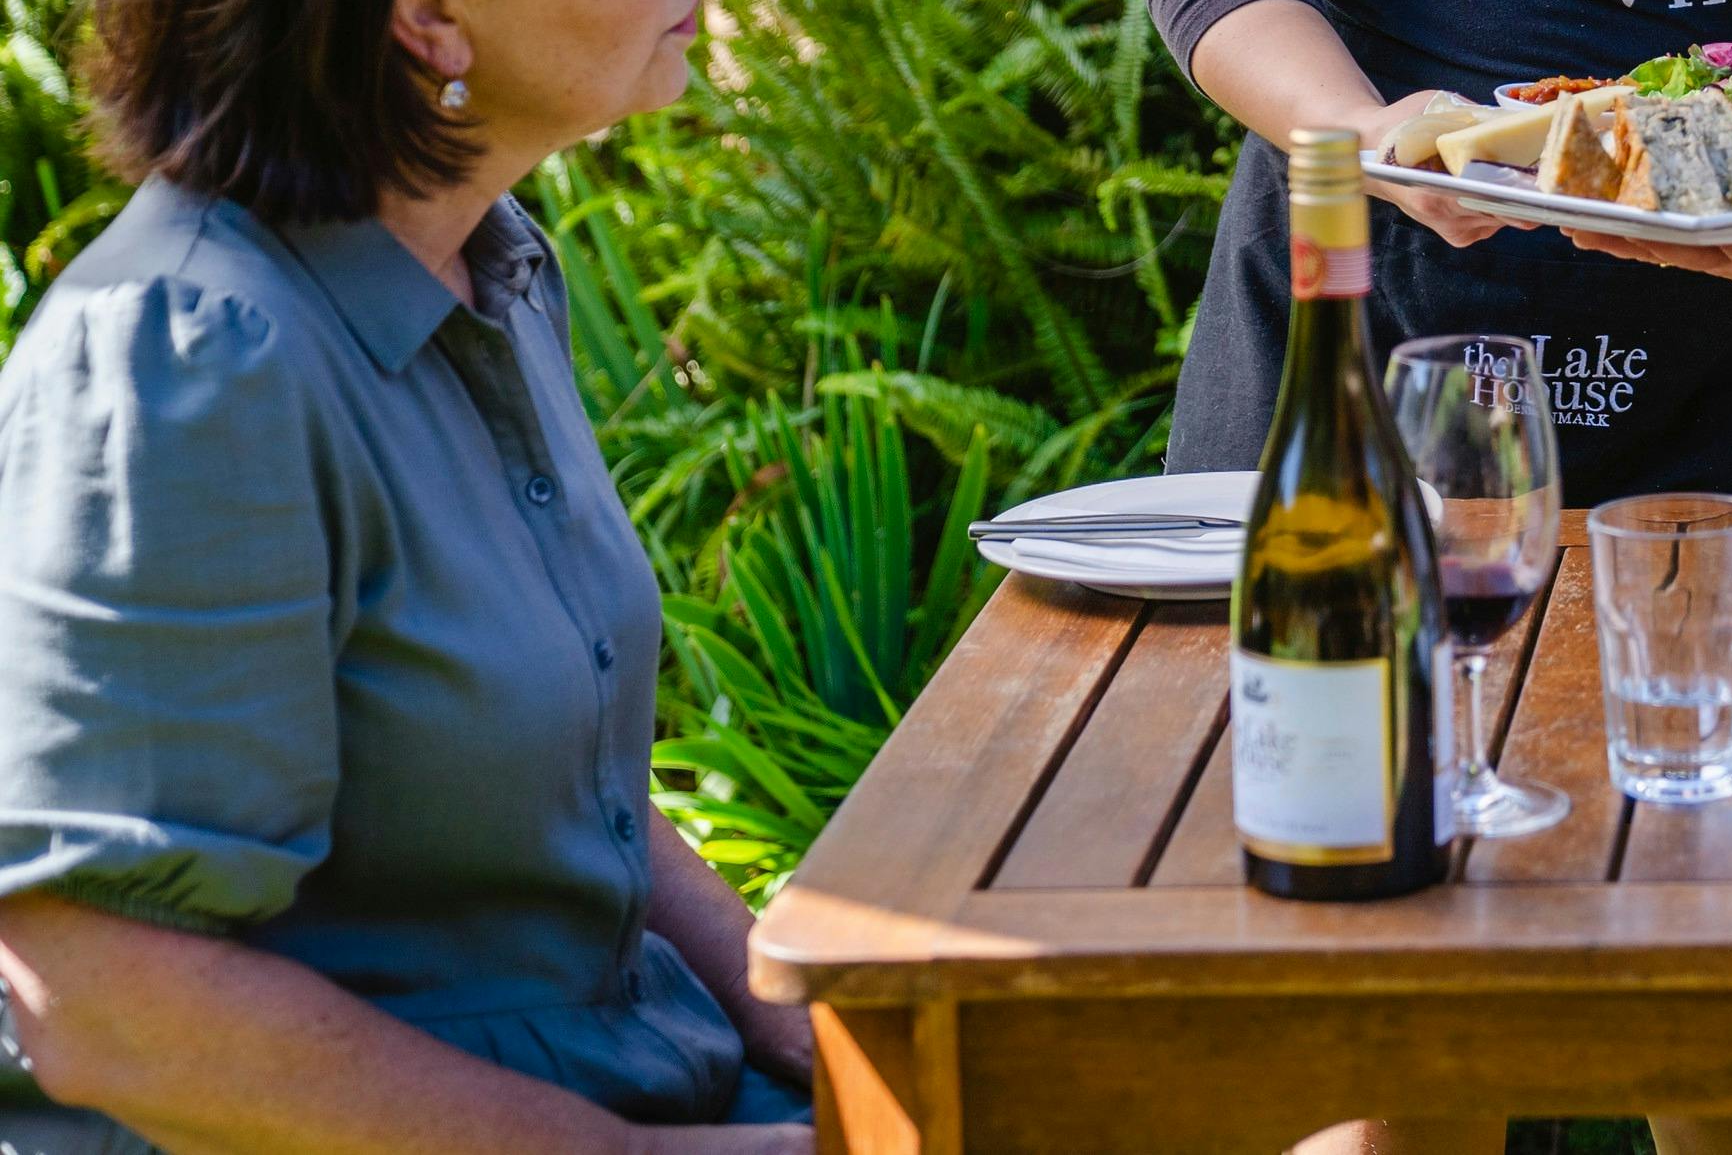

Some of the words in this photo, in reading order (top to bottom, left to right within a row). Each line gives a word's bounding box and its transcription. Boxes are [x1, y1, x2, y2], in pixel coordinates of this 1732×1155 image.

[1464, 336, 1511, 379] the
[1530, 335, 1648, 379] Lake
[1470, 375, 1634, 413] House
